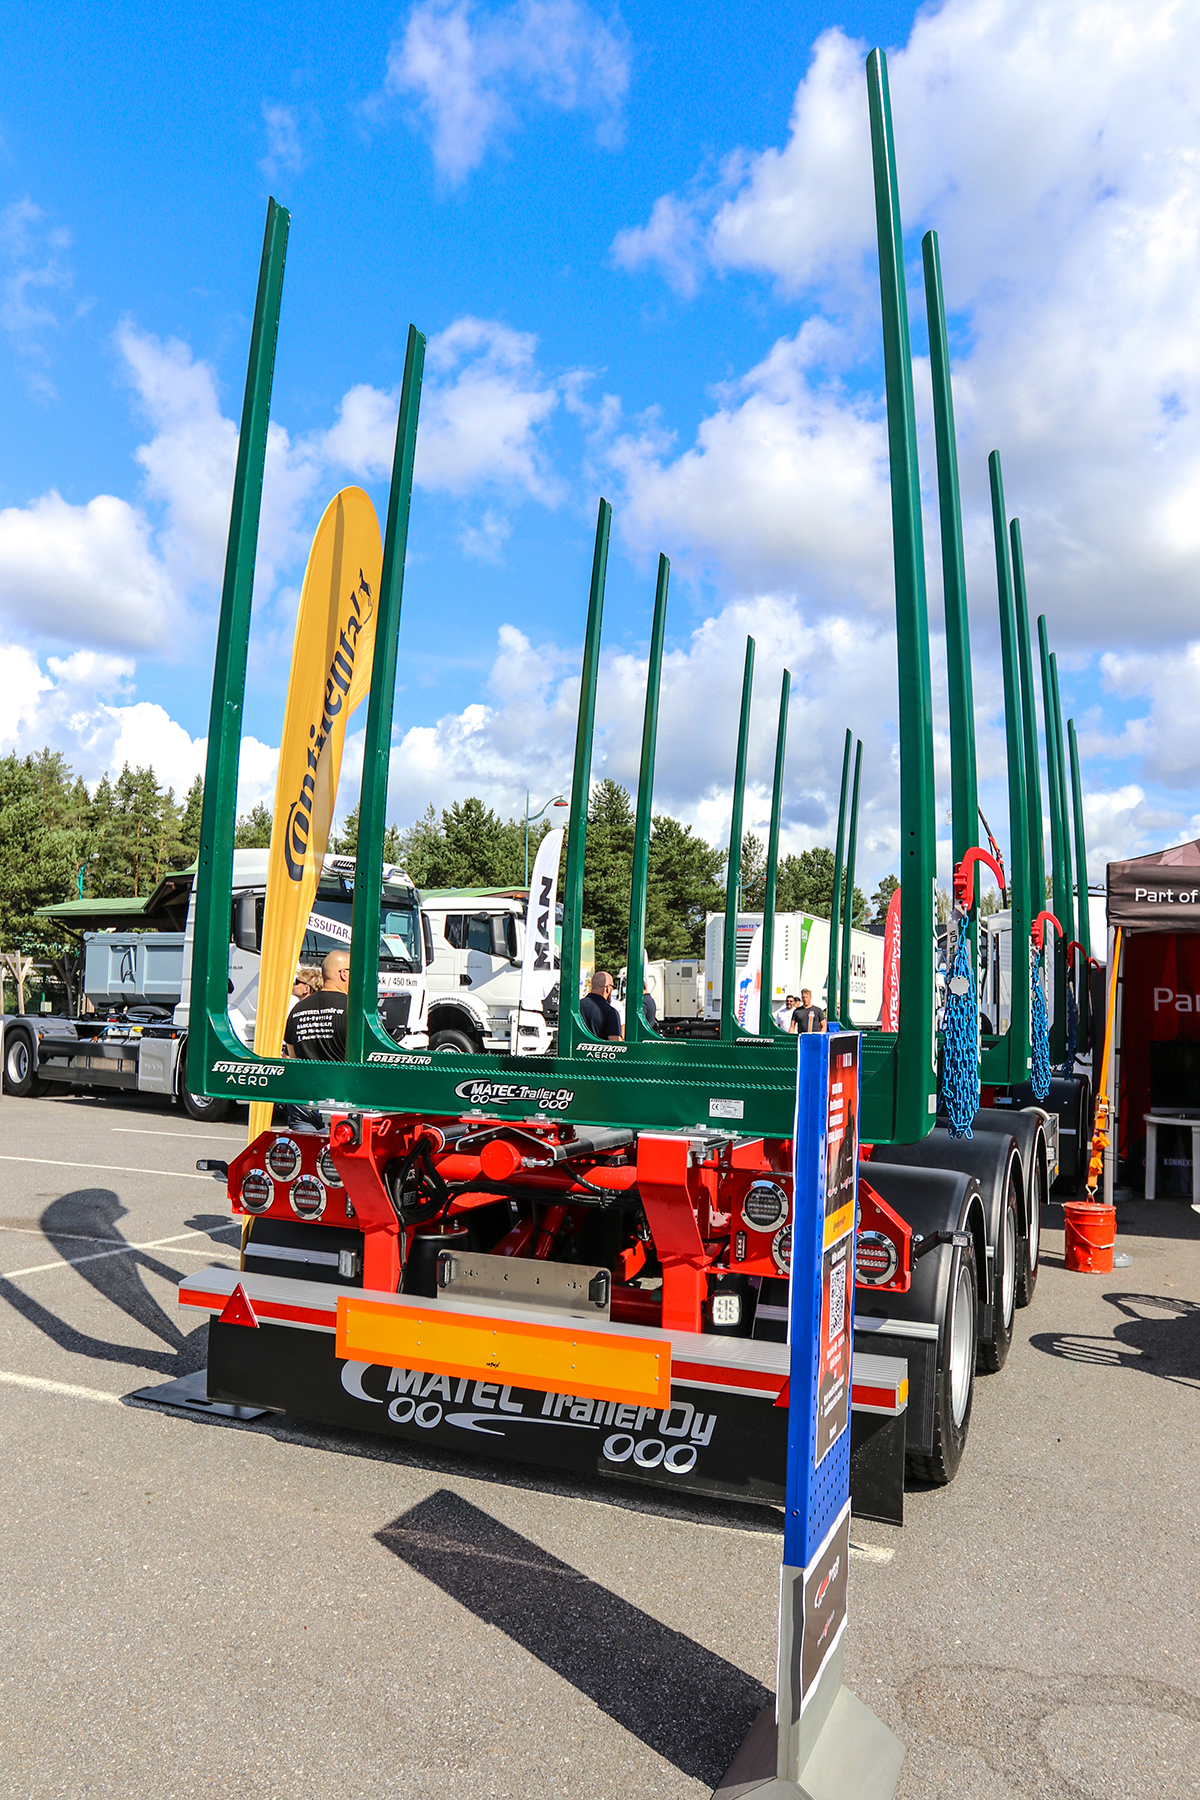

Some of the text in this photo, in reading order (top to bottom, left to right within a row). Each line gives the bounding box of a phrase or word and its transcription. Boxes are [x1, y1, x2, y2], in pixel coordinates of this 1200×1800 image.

[285, 590, 362, 882] Continental
[1135, 888, 1199, 903] Part of
[533, 876, 553, 971] MAN
[392, 977, 405, 986] 450
[406, 978, 418, 987] tkm
[586, 1052, 616, 1060] AERO
[226, 1074, 268, 1087] AERO
[658, 1400, 718, 1447] Oy
